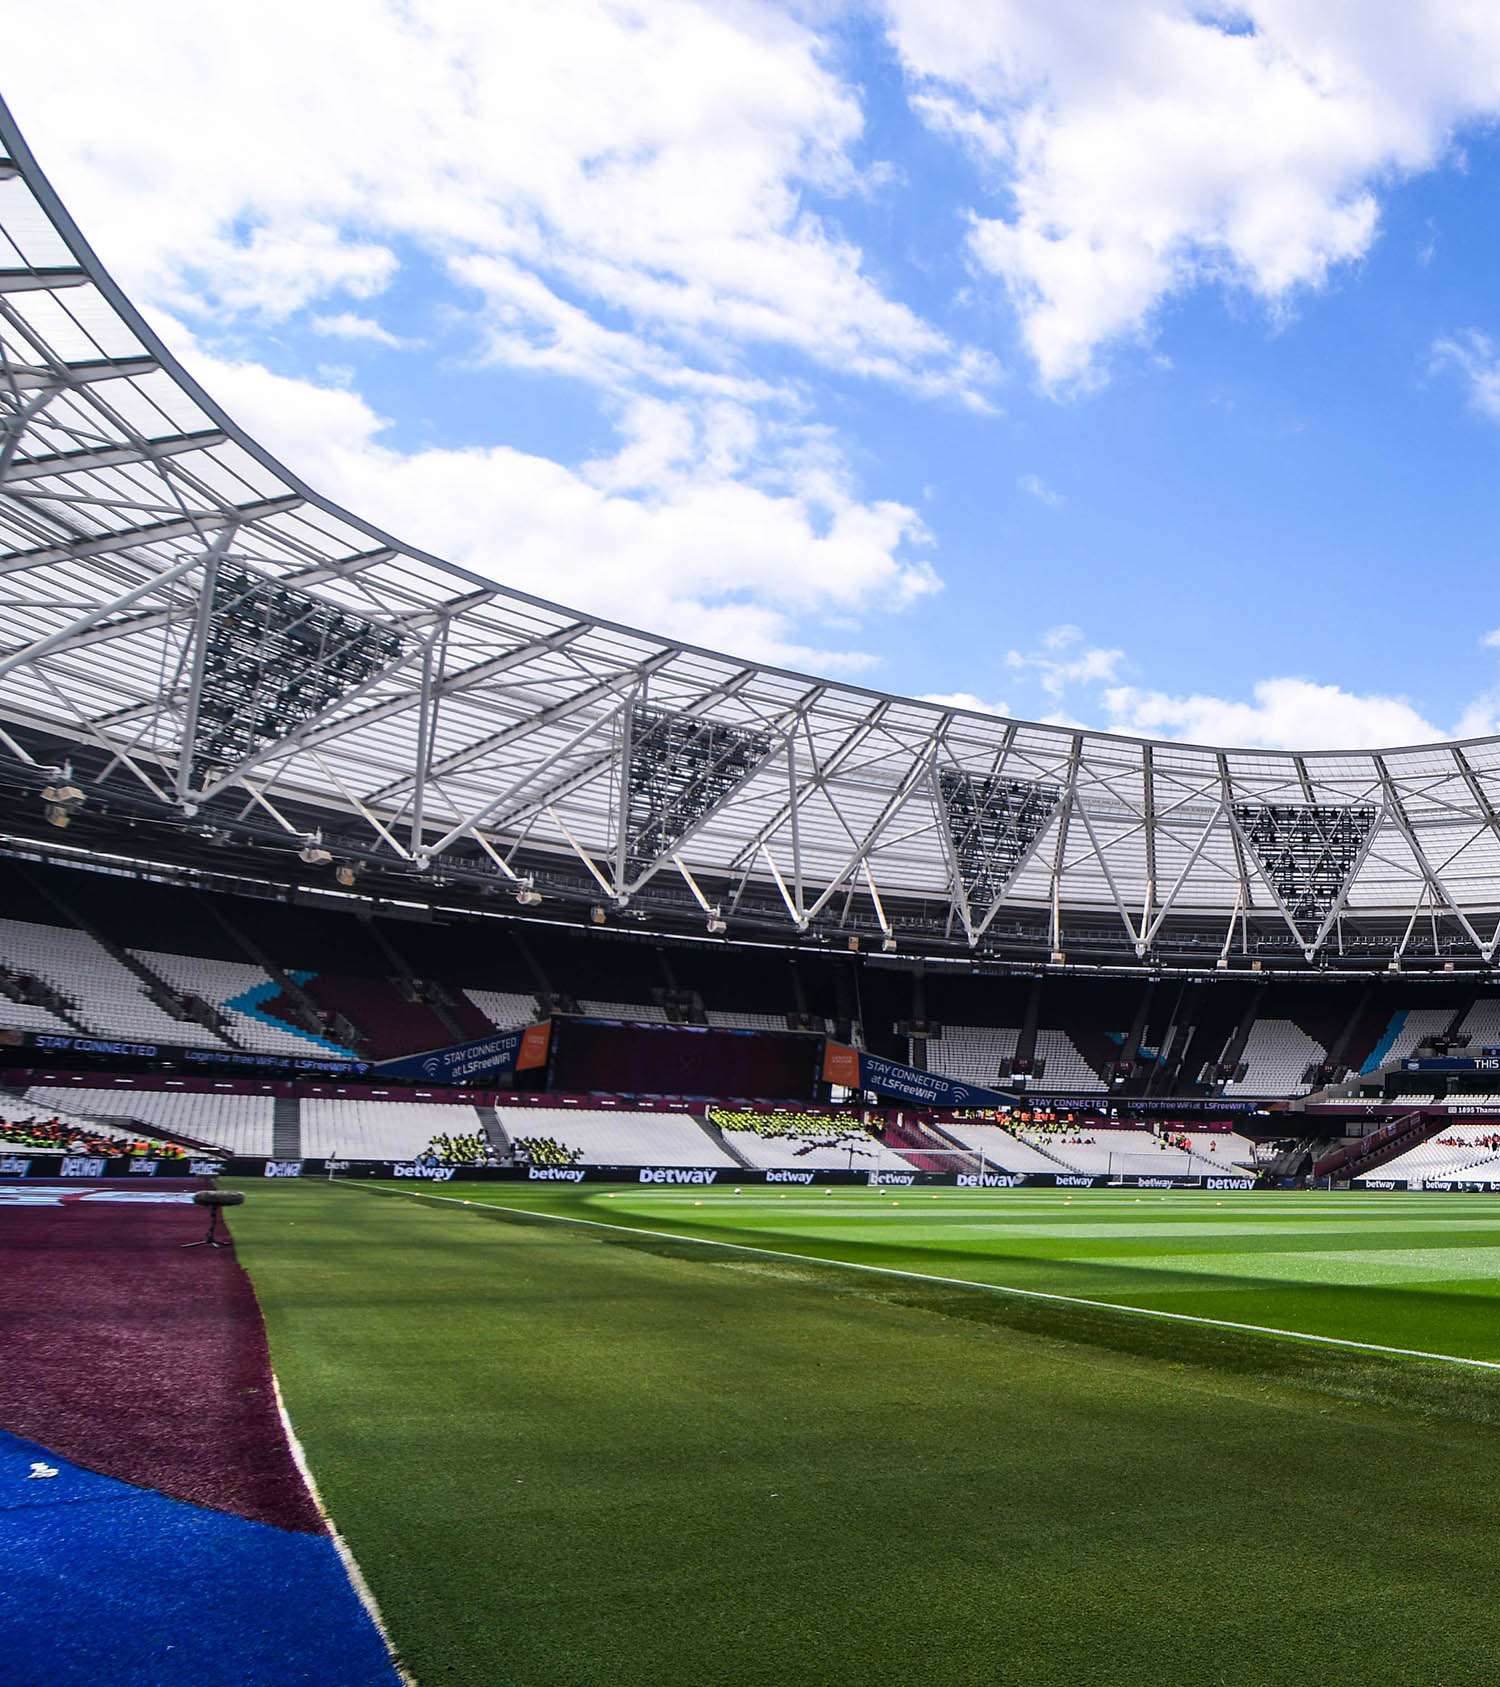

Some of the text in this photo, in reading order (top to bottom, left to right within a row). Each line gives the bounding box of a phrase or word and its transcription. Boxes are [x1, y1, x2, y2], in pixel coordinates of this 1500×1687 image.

[36, 1035, 158, 1056] STAY CONNECTED
[443, 1050, 467, 1065] STAY
[467, 1037, 517, 1058] CONNECTED
[1474, 1059, 1499, 1069] THIS
[452, 1065, 462, 1077] at
[867, 1060, 948, 1092] STAY CONNECTED
[871, 1074, 881, 1084] at
[1028, 1098, 1108, 1108] STAY CONNECTED
[393, 1165, 455, 1181] betway
[528, 1167, 586, 1183] betway
[639, 1168, 717, 1184] betway
[766, 1170, 814, 1185] betway
[1056, 1175, 1093, 1188] betway
[1207, 1177, 1256, 1190] betway
[1365, 1180, 1395, 1190] betway
[1425, 1180, 1452, 1191] betway
